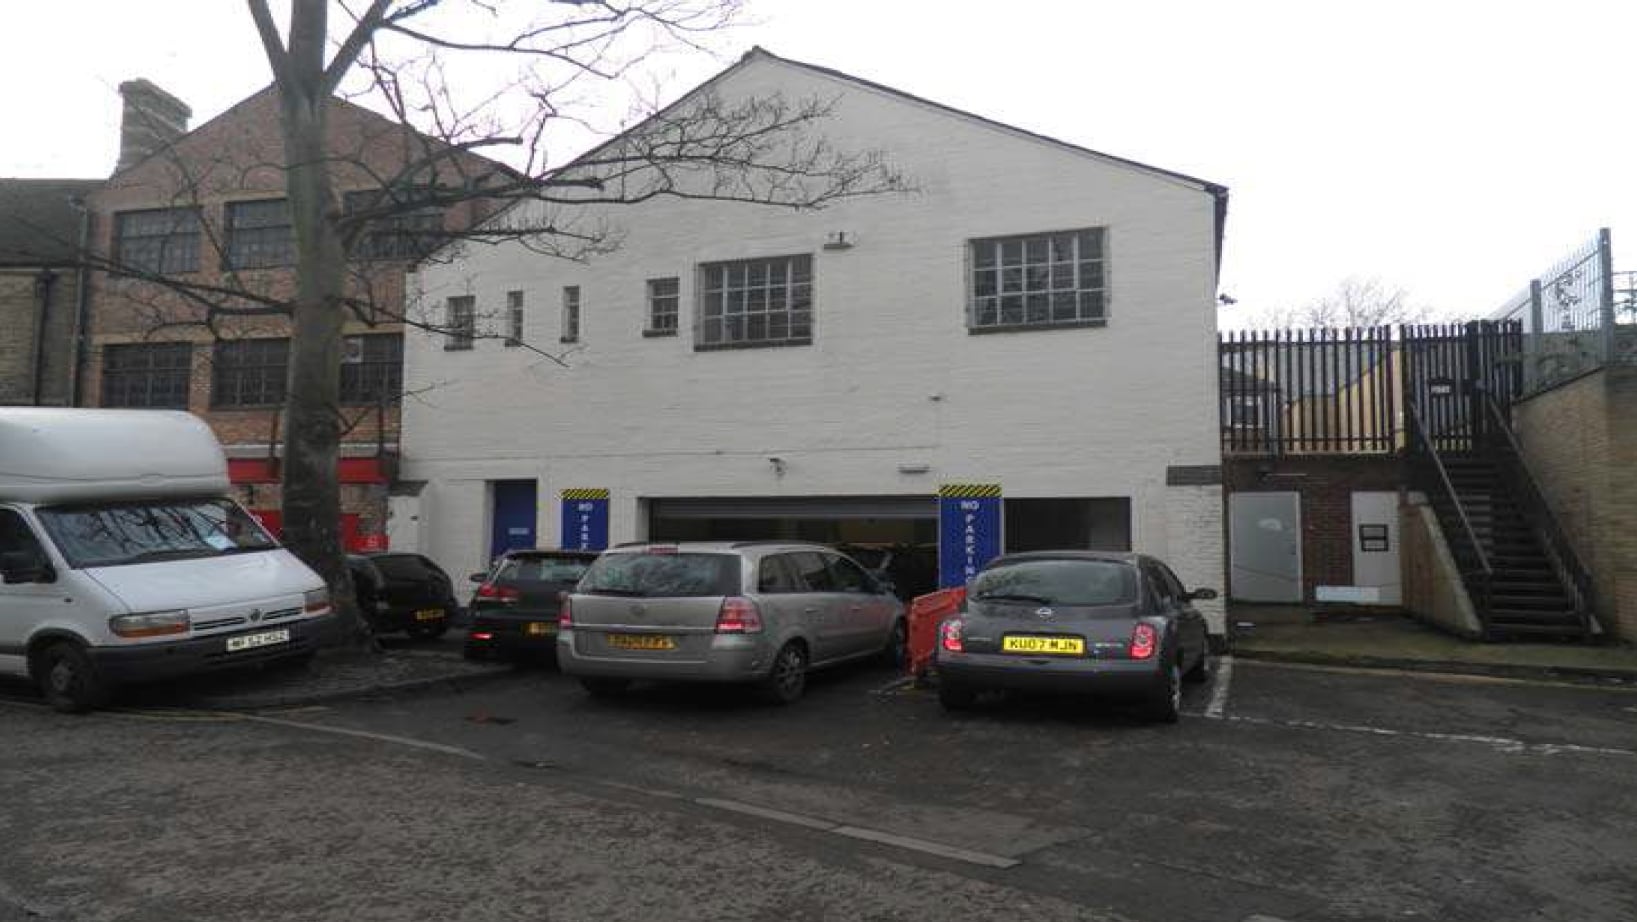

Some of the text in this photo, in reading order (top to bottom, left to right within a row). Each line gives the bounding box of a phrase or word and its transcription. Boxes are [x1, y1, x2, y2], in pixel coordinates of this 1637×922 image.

[578, 503, 593, 511] NO
[961, 501, 980, 510] NO
[1009, 638, 1078, 651] KU07 MJN
